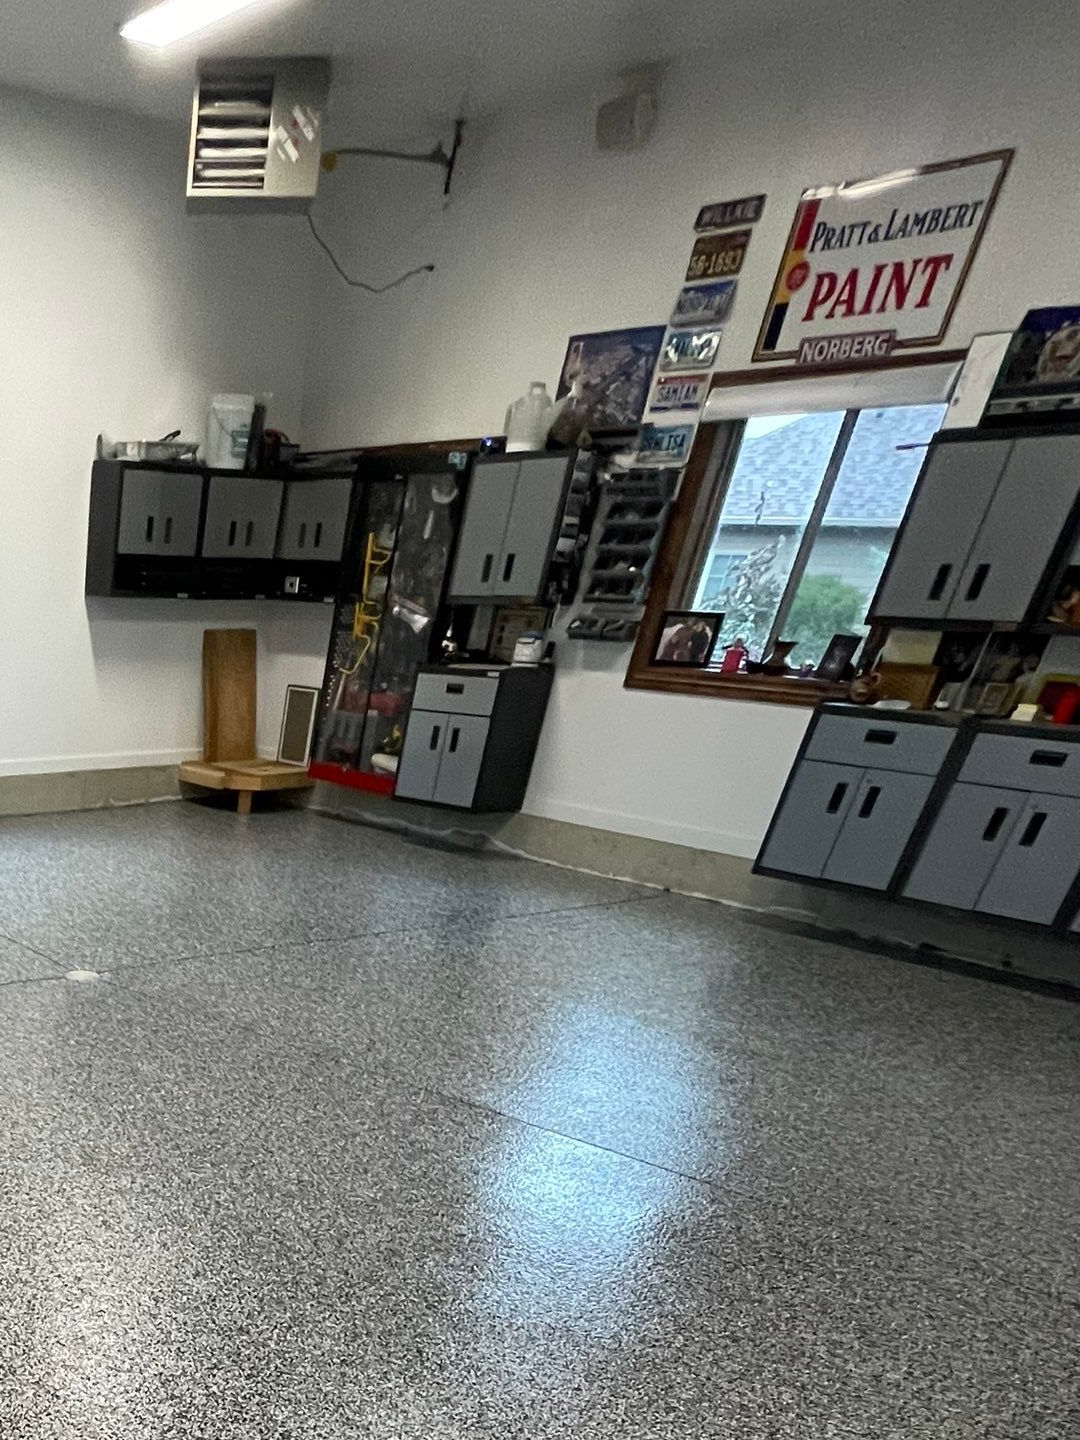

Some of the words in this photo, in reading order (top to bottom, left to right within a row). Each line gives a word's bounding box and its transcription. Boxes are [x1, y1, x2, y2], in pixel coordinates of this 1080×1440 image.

[809, 220, 871, 253] PRATT
[884, 201, 985, 241] LAMBERT
[802, 253, 954, 322] PAINT
[799, 335, 889, 364] NORBERG
